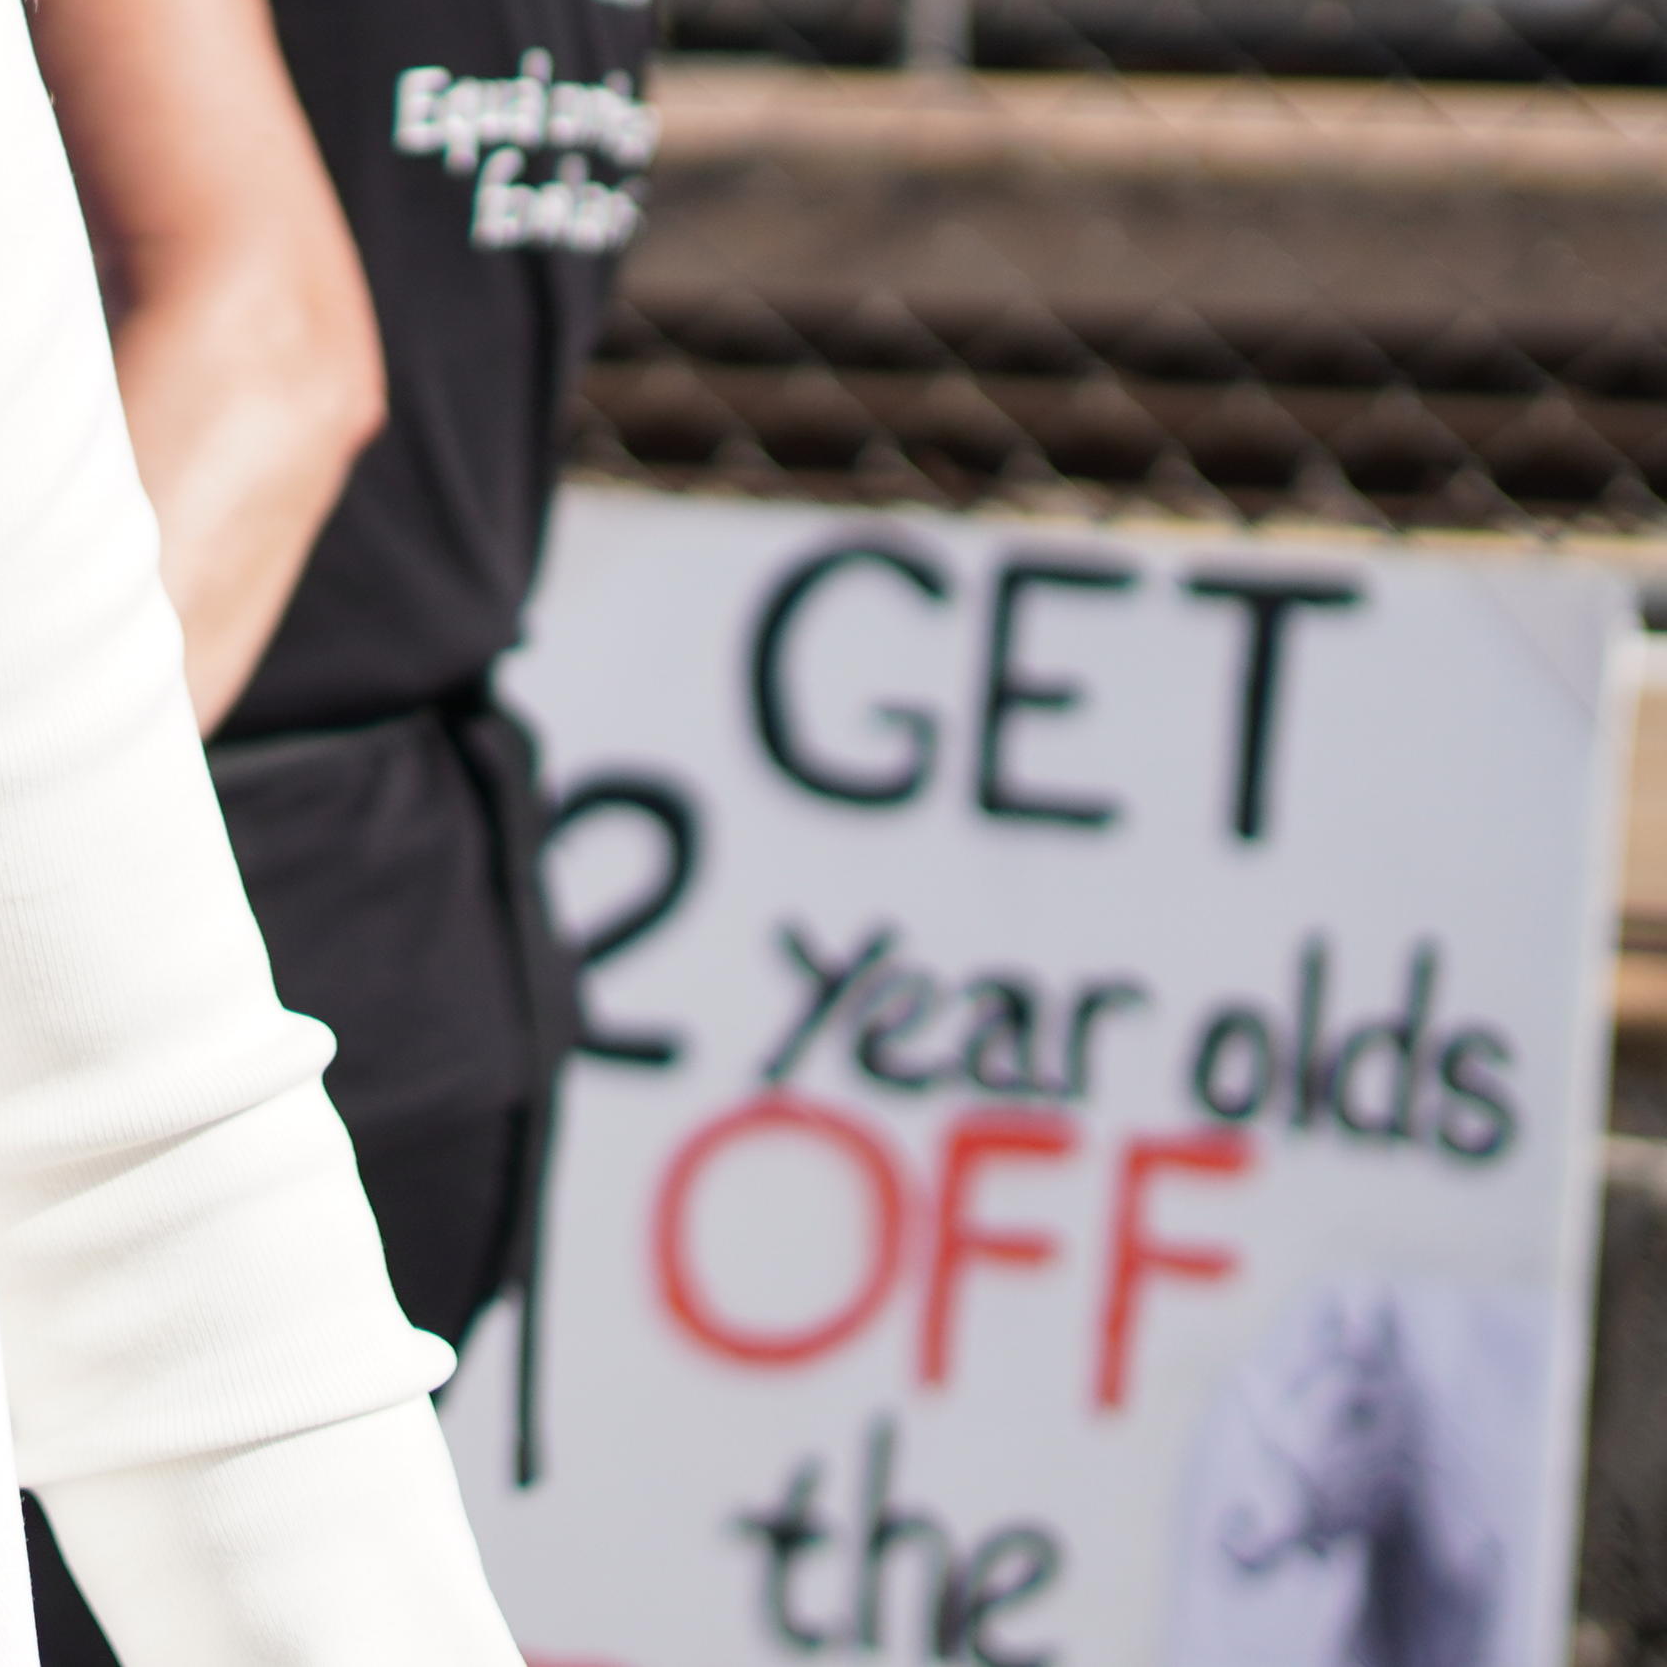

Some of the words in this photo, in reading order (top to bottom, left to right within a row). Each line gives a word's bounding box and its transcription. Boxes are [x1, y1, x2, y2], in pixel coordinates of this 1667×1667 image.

[743, 524, 1371, 846] GET
[537, 764, 705, 1070] 2
[1185, 932, 1523, 1168] olds
[647, 1090, 1259, 1414] OFF
[729, 1408, 1069, 1667] the
